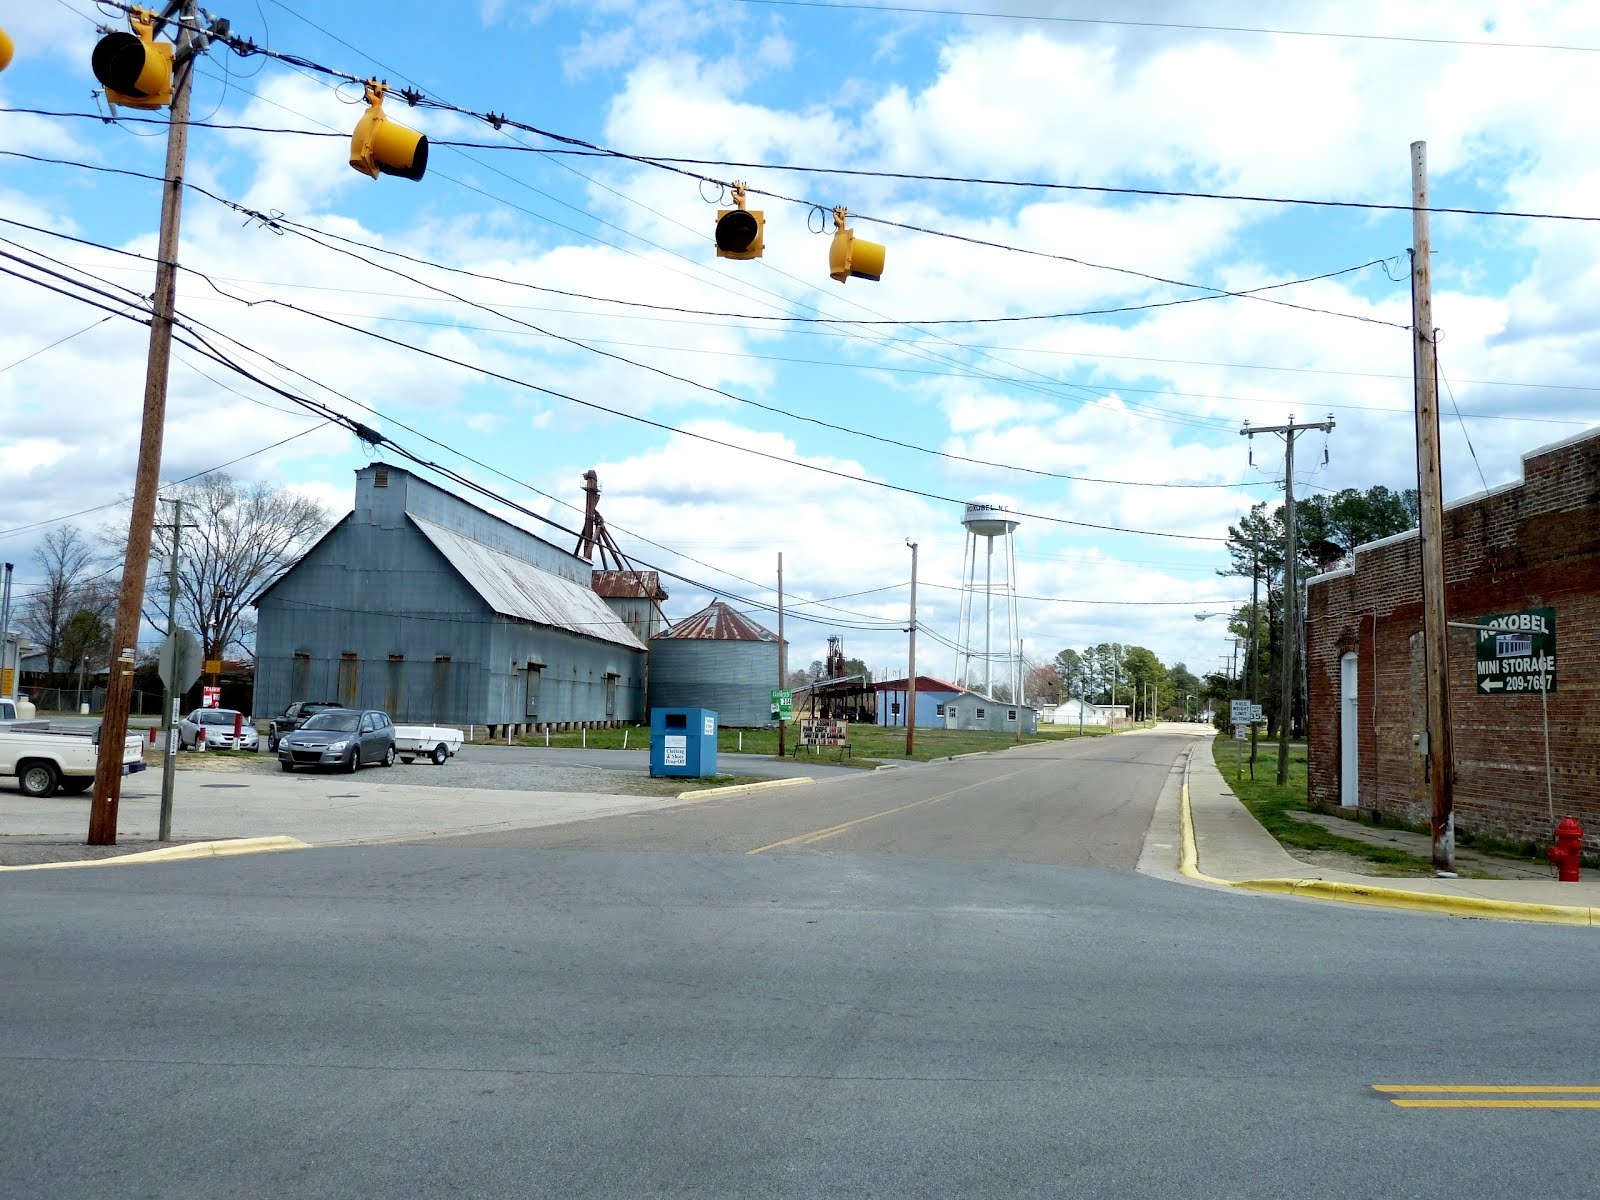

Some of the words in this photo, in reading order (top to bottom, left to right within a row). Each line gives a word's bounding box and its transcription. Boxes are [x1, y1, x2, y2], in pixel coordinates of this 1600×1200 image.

[1480, 614, 1549, 643] ROXOBEL
[1477, 659, 1500, 675] MINI
[1502, 655, 1555, 674] STORAGE
[1505, 674, 1553, 691] 209-7697
